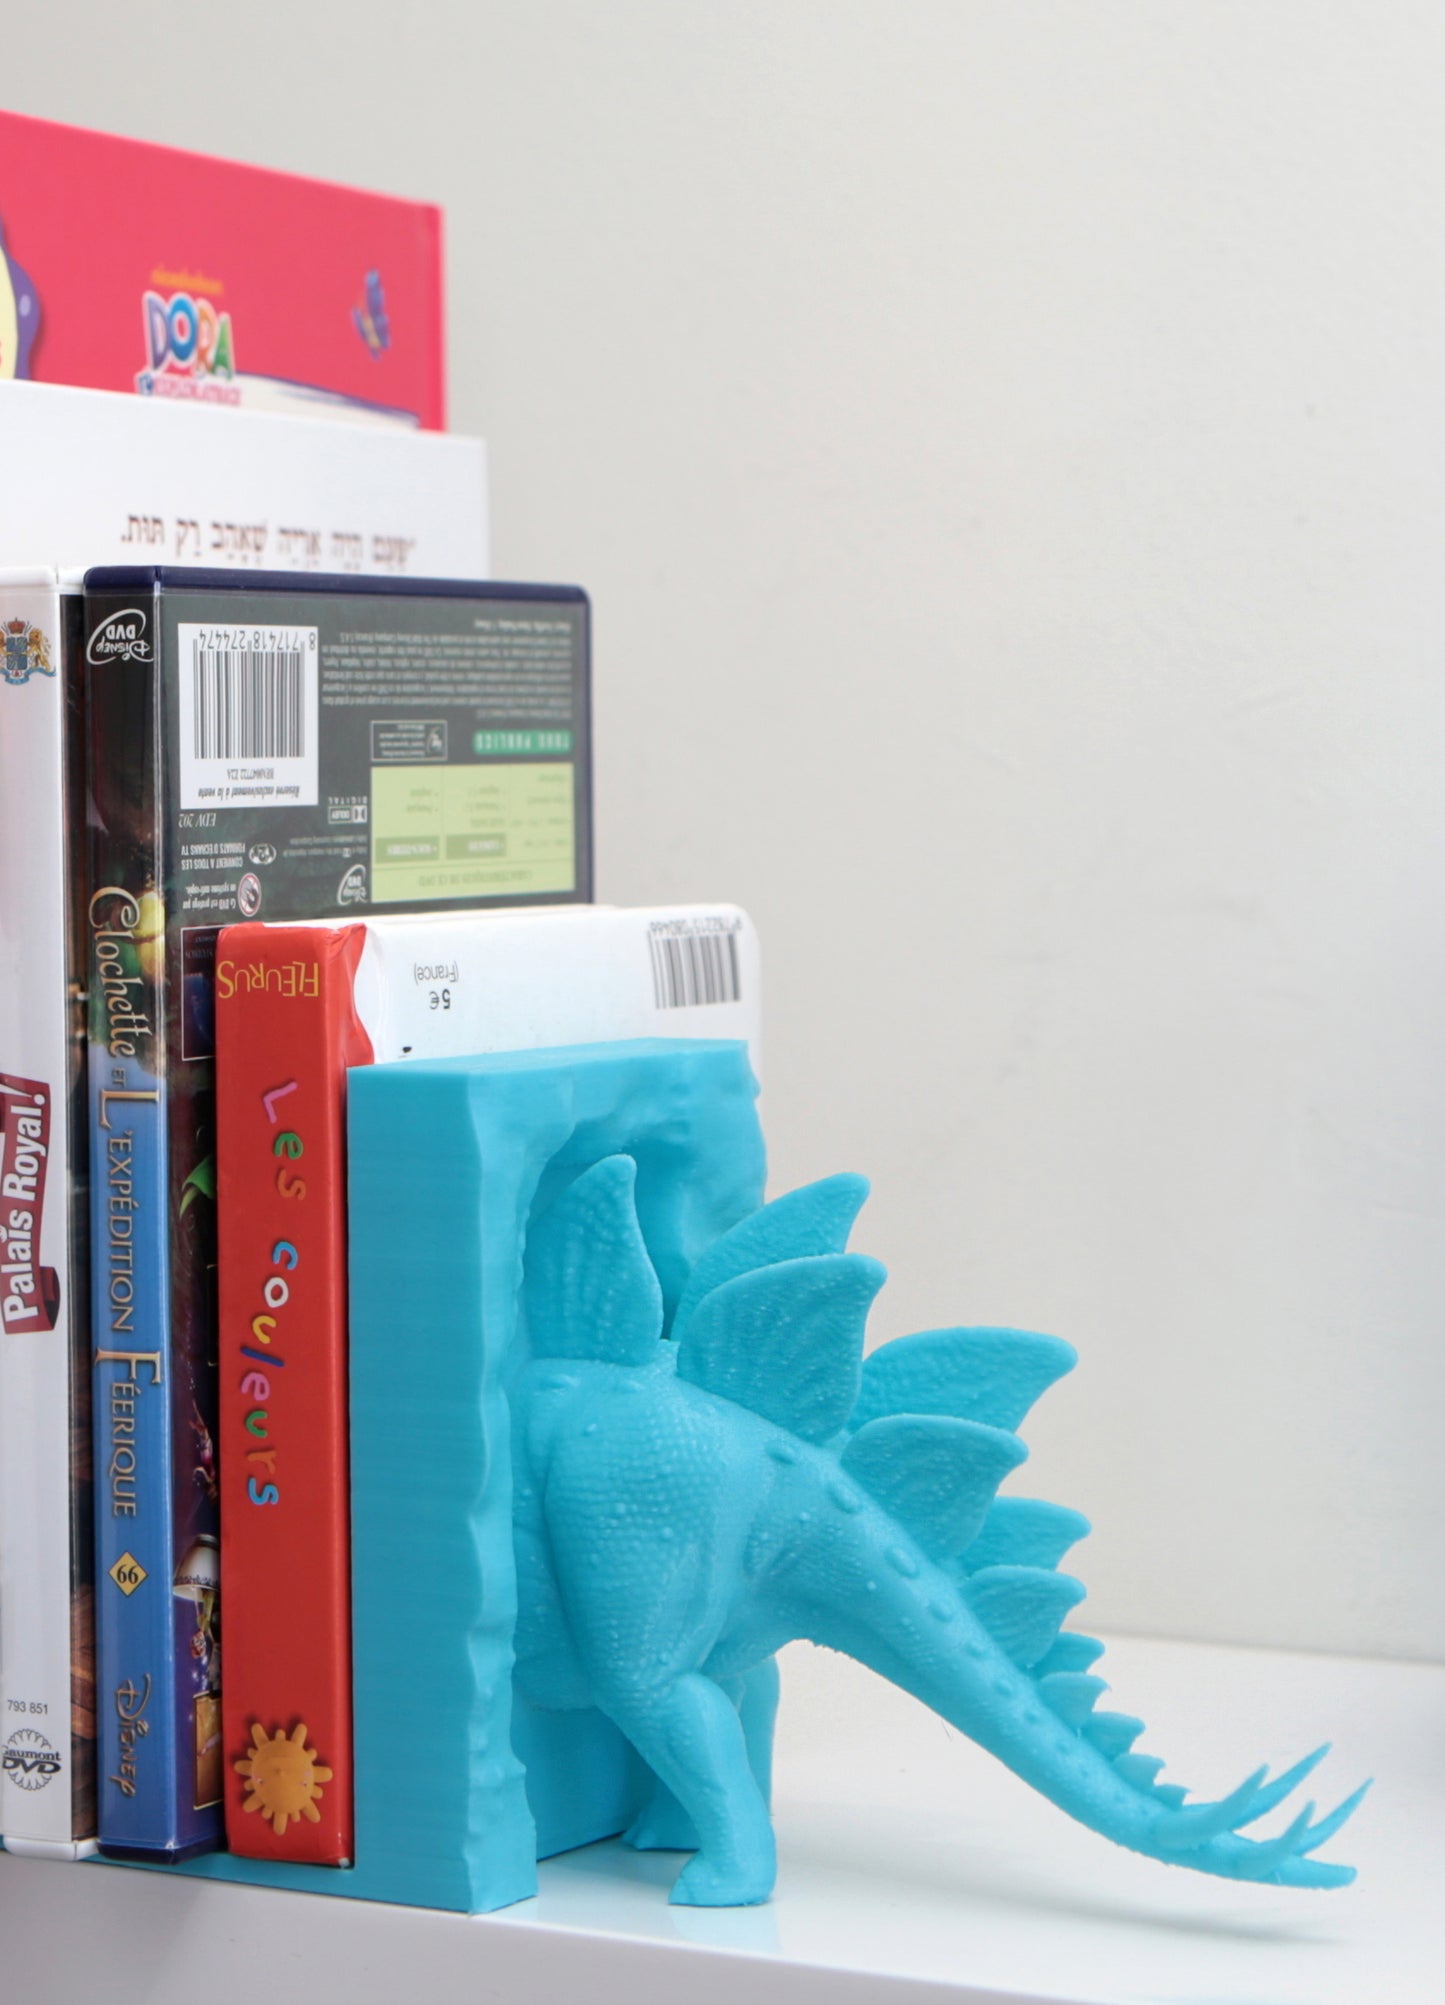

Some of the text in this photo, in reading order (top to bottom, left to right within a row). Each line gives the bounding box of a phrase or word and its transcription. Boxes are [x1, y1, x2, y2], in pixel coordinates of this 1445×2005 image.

[144, 292, 234, 381] DORA
[96, 624, 154, 662] Disney DVD
[198, 628, 246, 649] 274474
[253, 630, 299, 650] 717418
[178, 812, 217, 828] EDV 202
[180, 845, 189, 856] TV
[181, 858, 193, 871] LES
[89, 885, 154, 1058] Clochette
[216, 960, 320, 999] FLEURUS
[414, 960, 460, 986] (France)
[263, 1080, 307, 1202] Les
[1, 1208, 39, 1322] Palais
[95, 1347, 162, 1518] FÉERIQUE
[7, 1699, 49, 1715] 793 851
[2, 1756, 61, 1773] DVD
